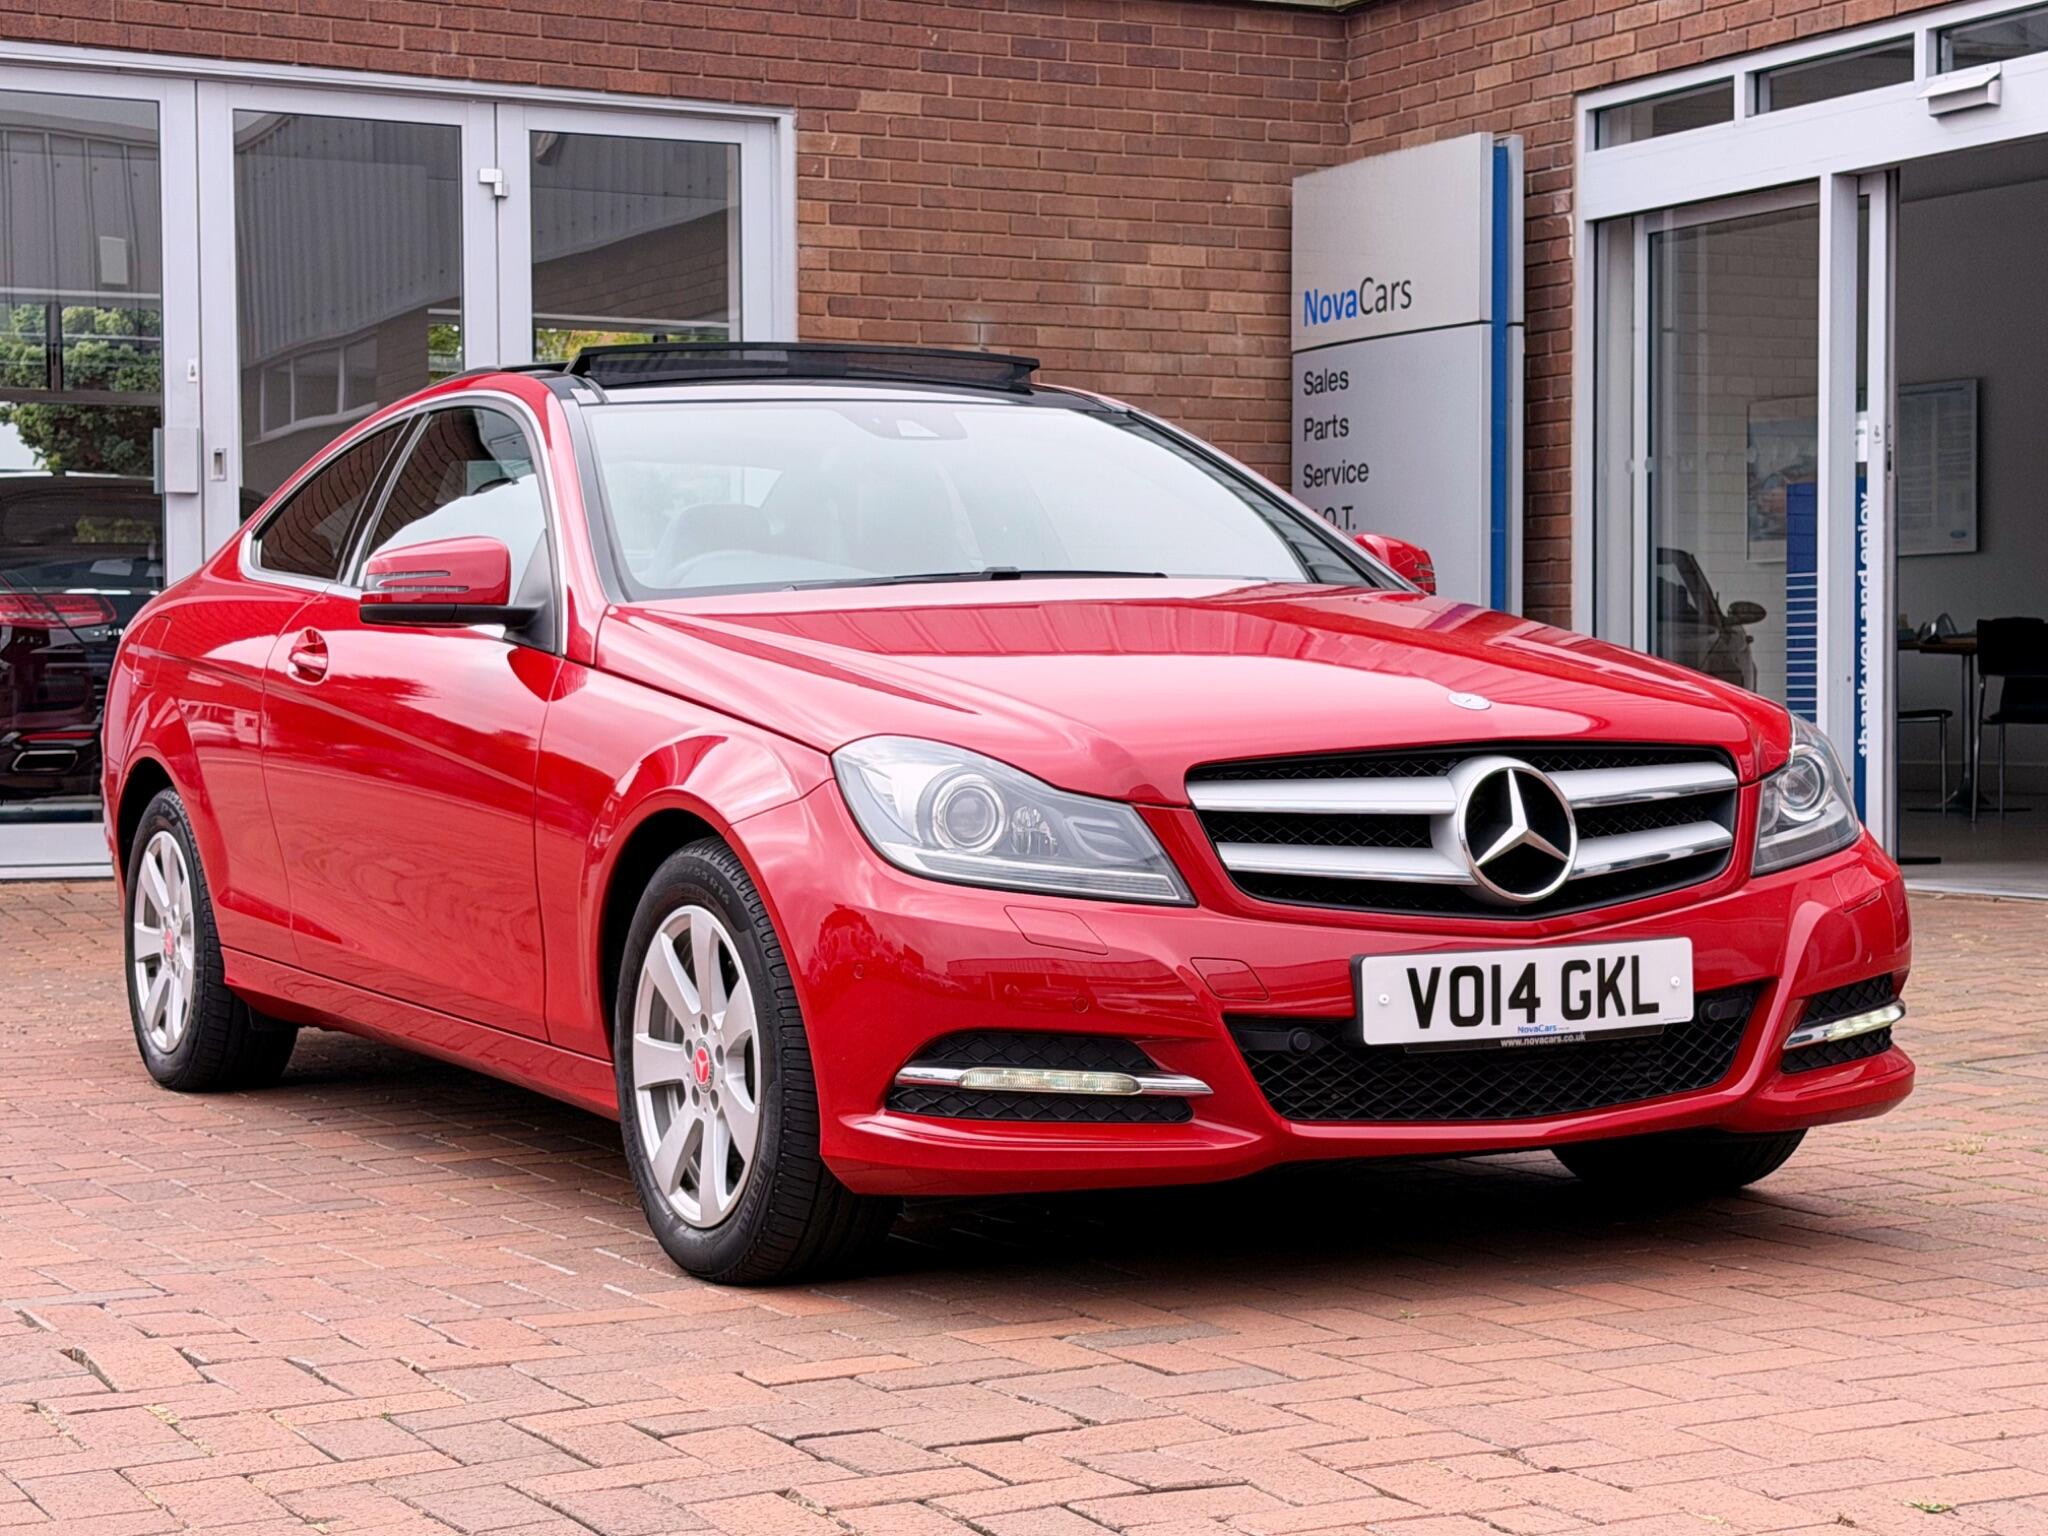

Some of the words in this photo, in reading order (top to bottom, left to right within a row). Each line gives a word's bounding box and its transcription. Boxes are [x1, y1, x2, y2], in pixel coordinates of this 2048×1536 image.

[1304, 277, 1412, 327] NovaCars
[1303, 367, 1349, 396] Sales
[1303, 414, 1349, 442] Parts
[1303, 460, 1369, 489] Service
[1406, 962, 1541, 1029] VO14
[1561, 955, 1660, 1021] GKL
[1501, 1033, 1586, 1047] www.novacars.co.uk
[1518, 1024, 1557, 1033] NovaCars
